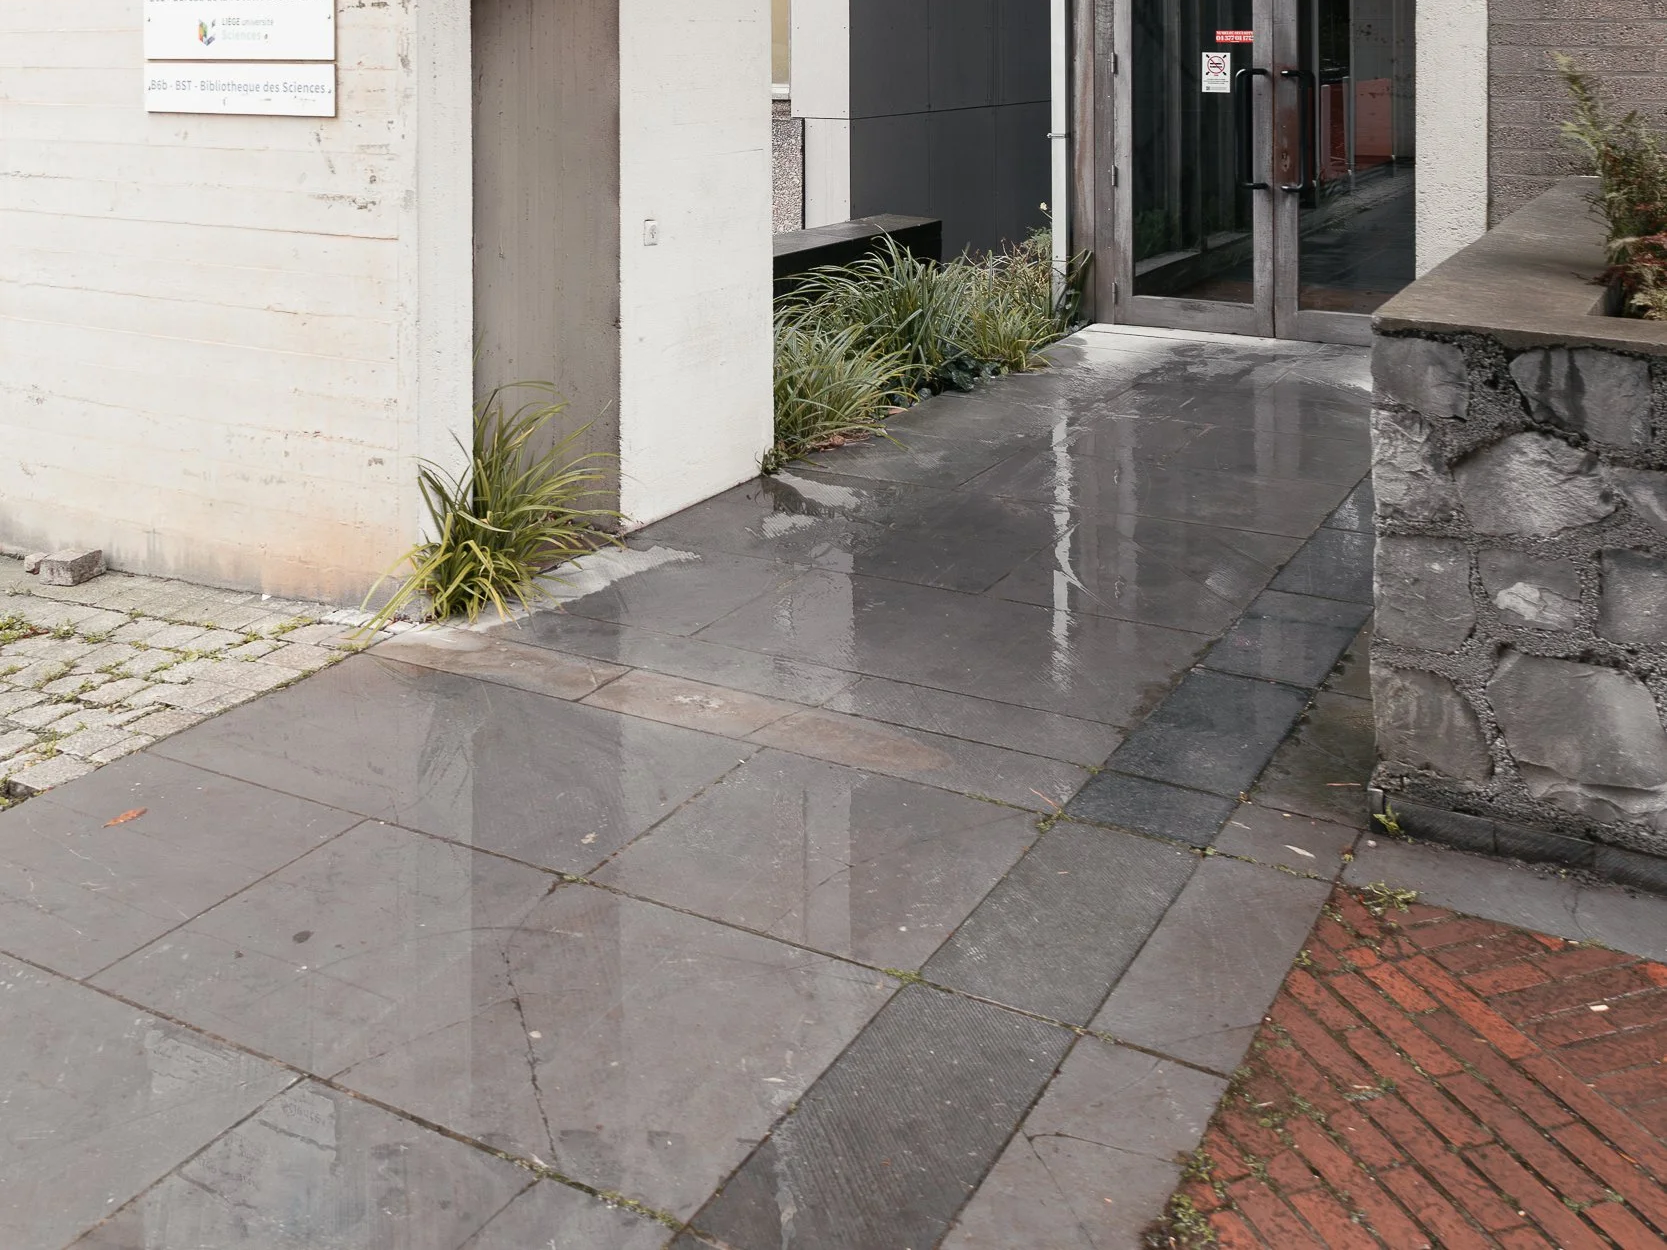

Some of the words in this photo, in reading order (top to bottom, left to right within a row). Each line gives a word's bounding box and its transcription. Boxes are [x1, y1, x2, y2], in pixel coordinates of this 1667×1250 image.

[221, 29, 261, 41] Sciences
[151, 80, 168, 91] B6b
[176, 80, 192, 91] BST
[263, 81, 279, 93] des
[283, 80, 326, 93] Sciences
